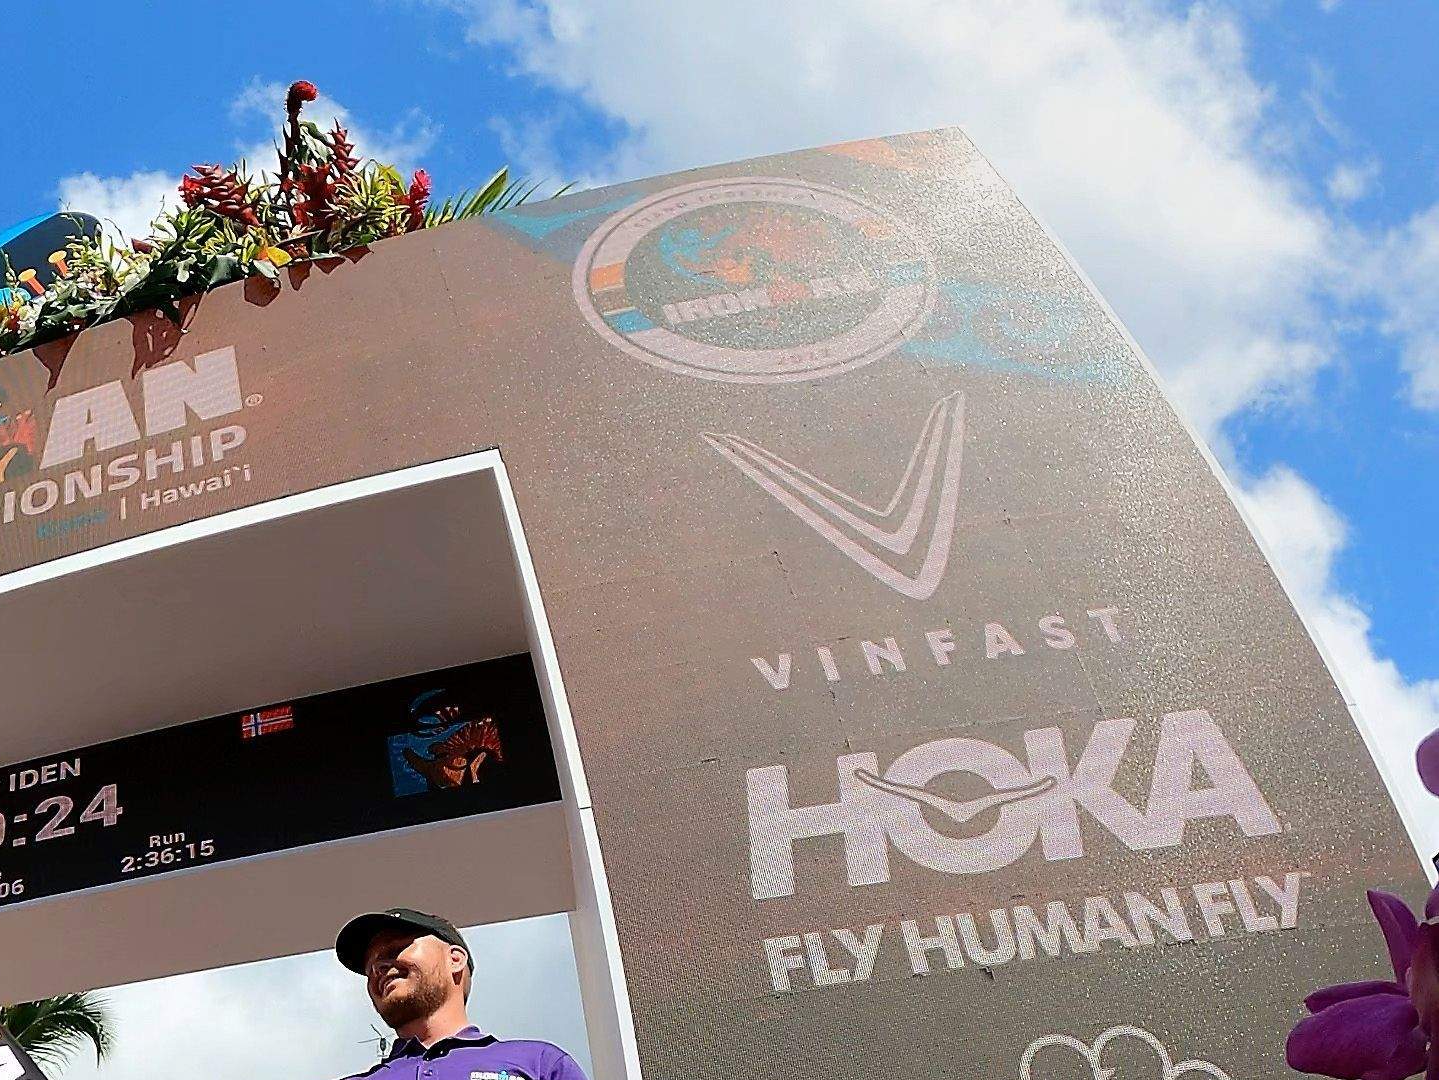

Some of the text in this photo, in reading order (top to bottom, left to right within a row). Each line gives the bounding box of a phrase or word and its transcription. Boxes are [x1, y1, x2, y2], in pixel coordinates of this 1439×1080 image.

[750, 606, 1126, 691] VINFAST
[8, 757, 82, 793] IDEN
[746, 708, 1282, 901] HOKA
[120, 839, 215, 874] 2:36:15
[149, 829, 186, 851] Run
[763, 870, 1312, 993] FLY HUMAN FLY
